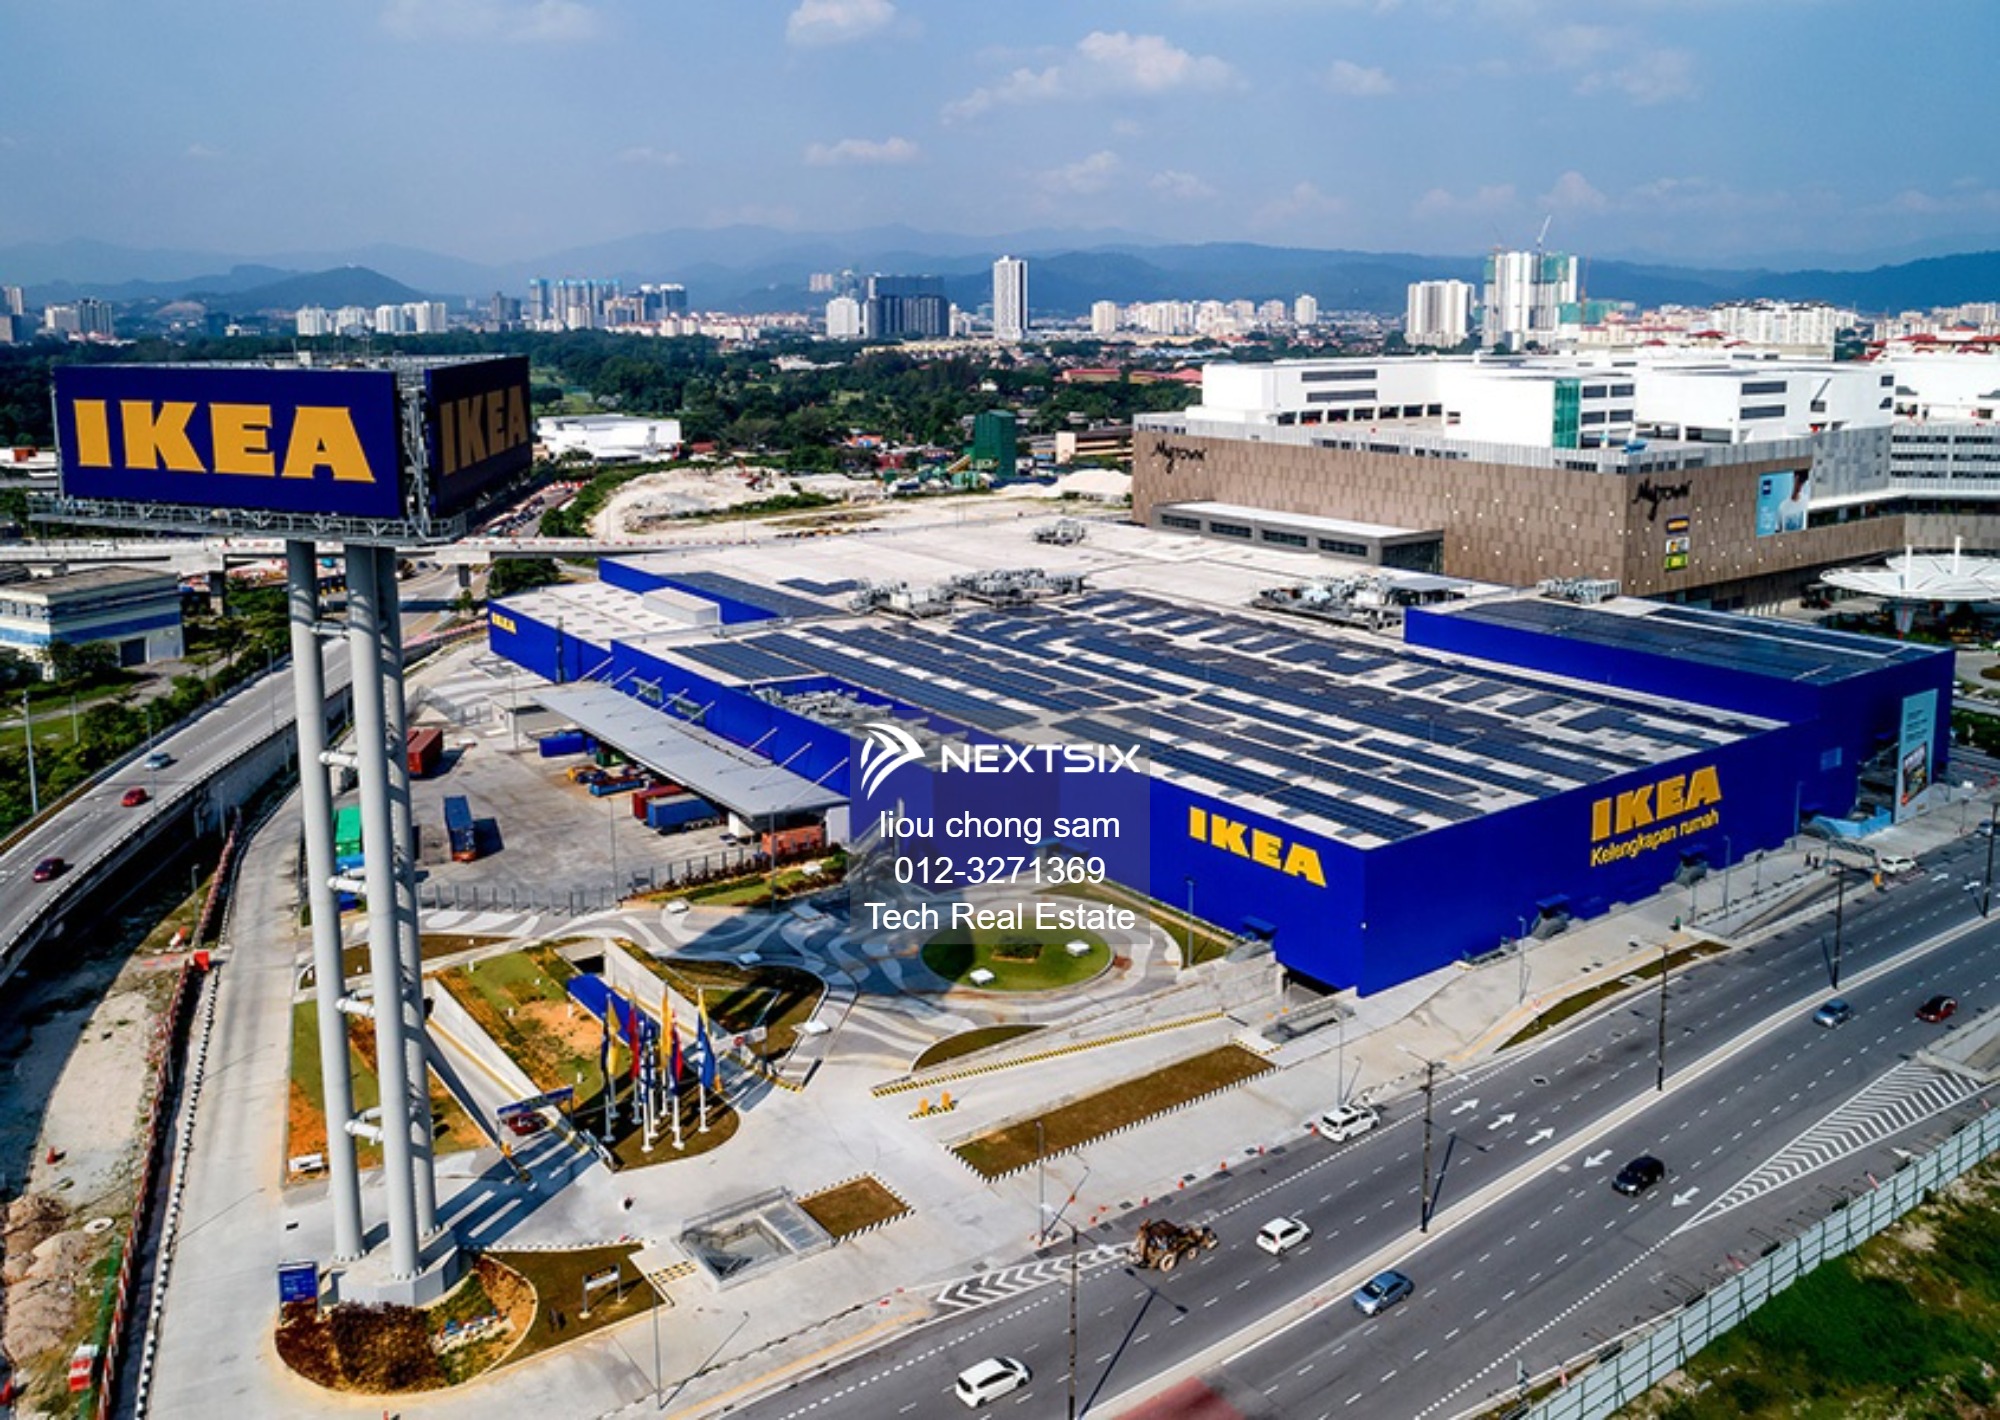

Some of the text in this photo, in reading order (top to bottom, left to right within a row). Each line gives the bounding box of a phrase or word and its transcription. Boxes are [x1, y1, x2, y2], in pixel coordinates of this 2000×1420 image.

[73, 399, 375, 483] IKEA
[440, 384, 528, 476] IKEA
[1590, 808, 1719, 867] Kelengkapan rumah
[1591, 764, 1722, 842] IKEA
[1188, 806, 1328, 888] IKEA
